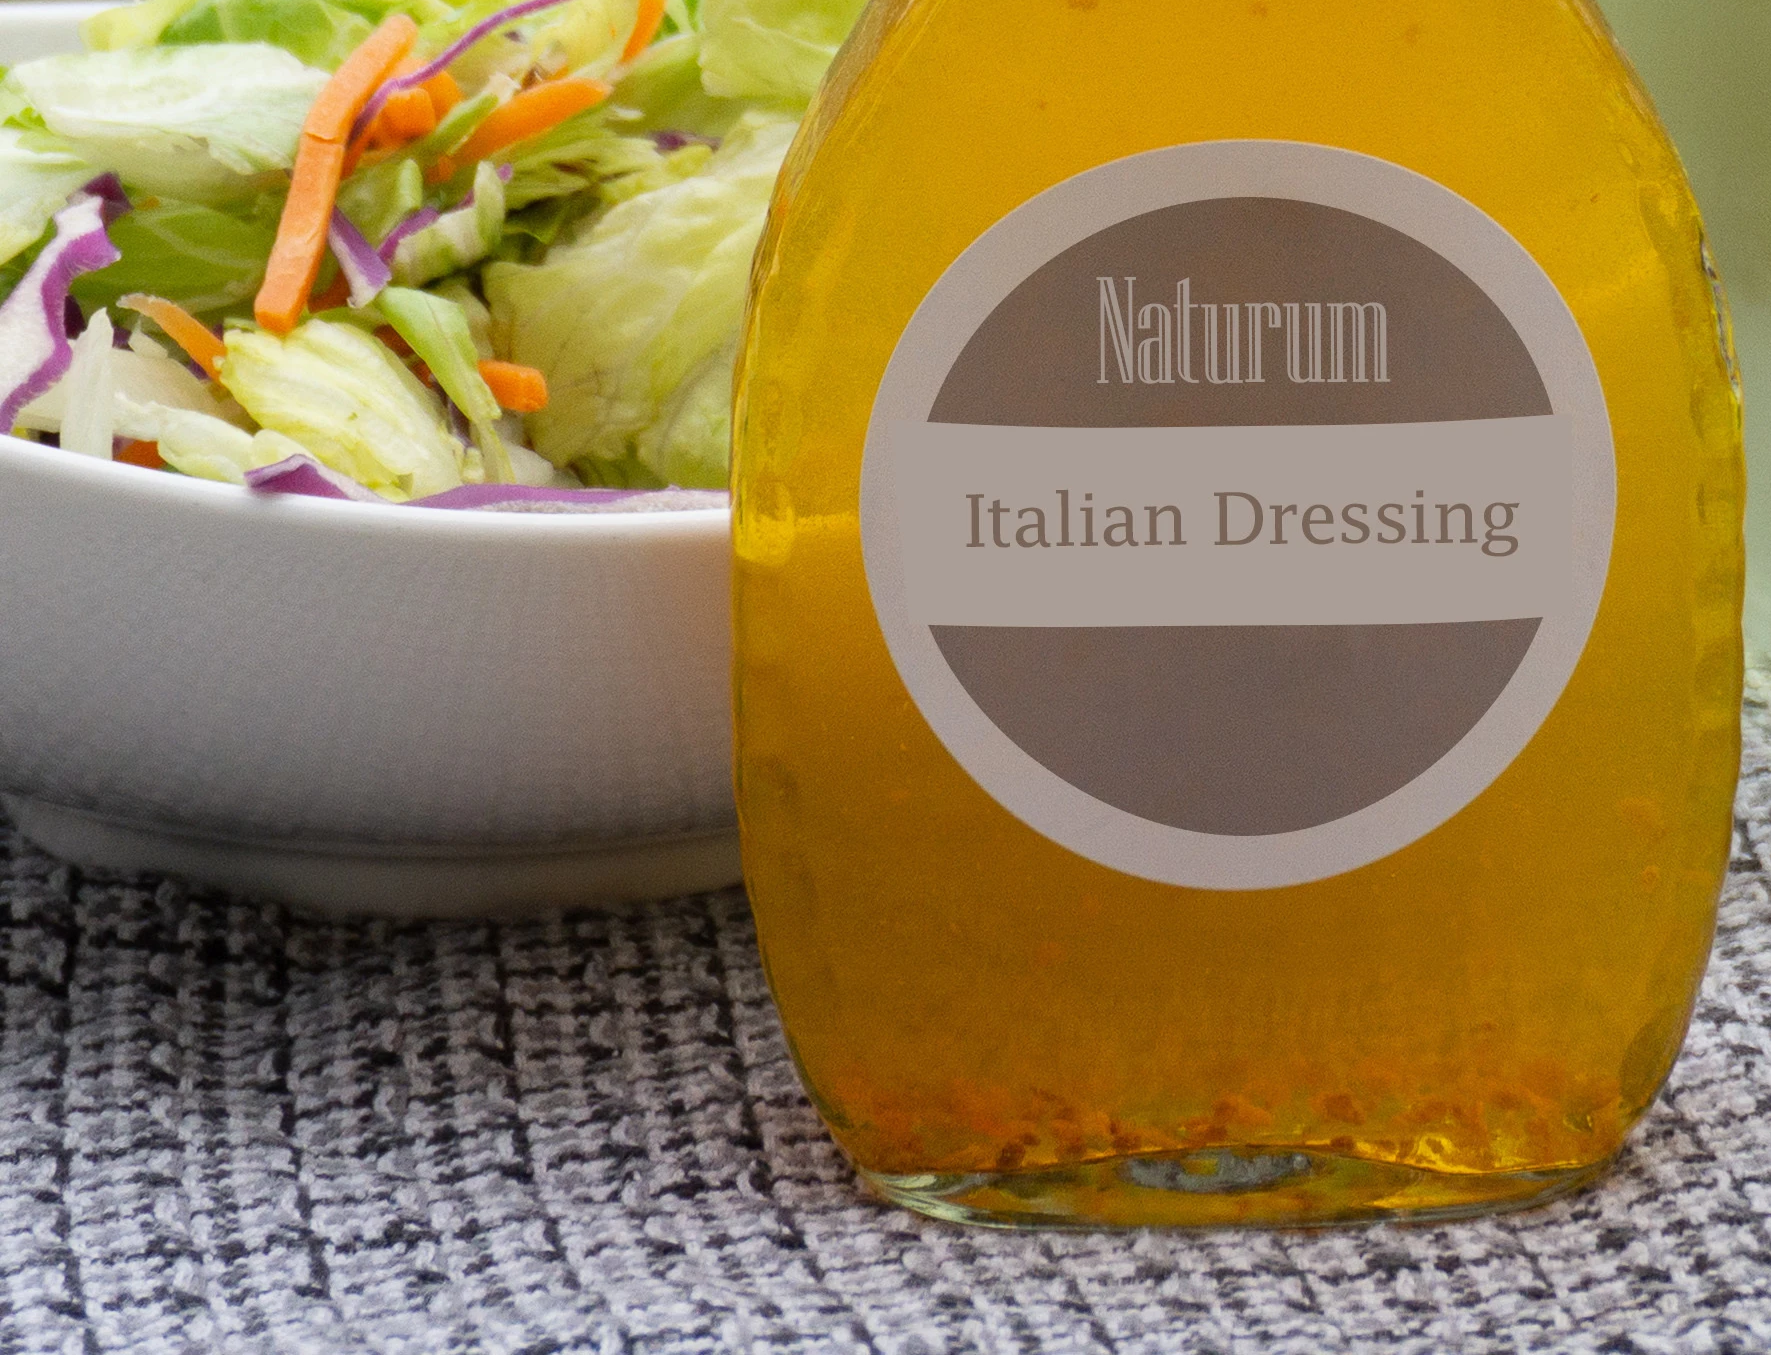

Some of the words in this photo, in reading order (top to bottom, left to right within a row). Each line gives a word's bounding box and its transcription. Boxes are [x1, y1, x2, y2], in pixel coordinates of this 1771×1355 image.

[1096, 276, 1391, 385] Naturum
[965, 489, 1187, 548] Italian
[1213, 489, 1520, 557] Dressing
